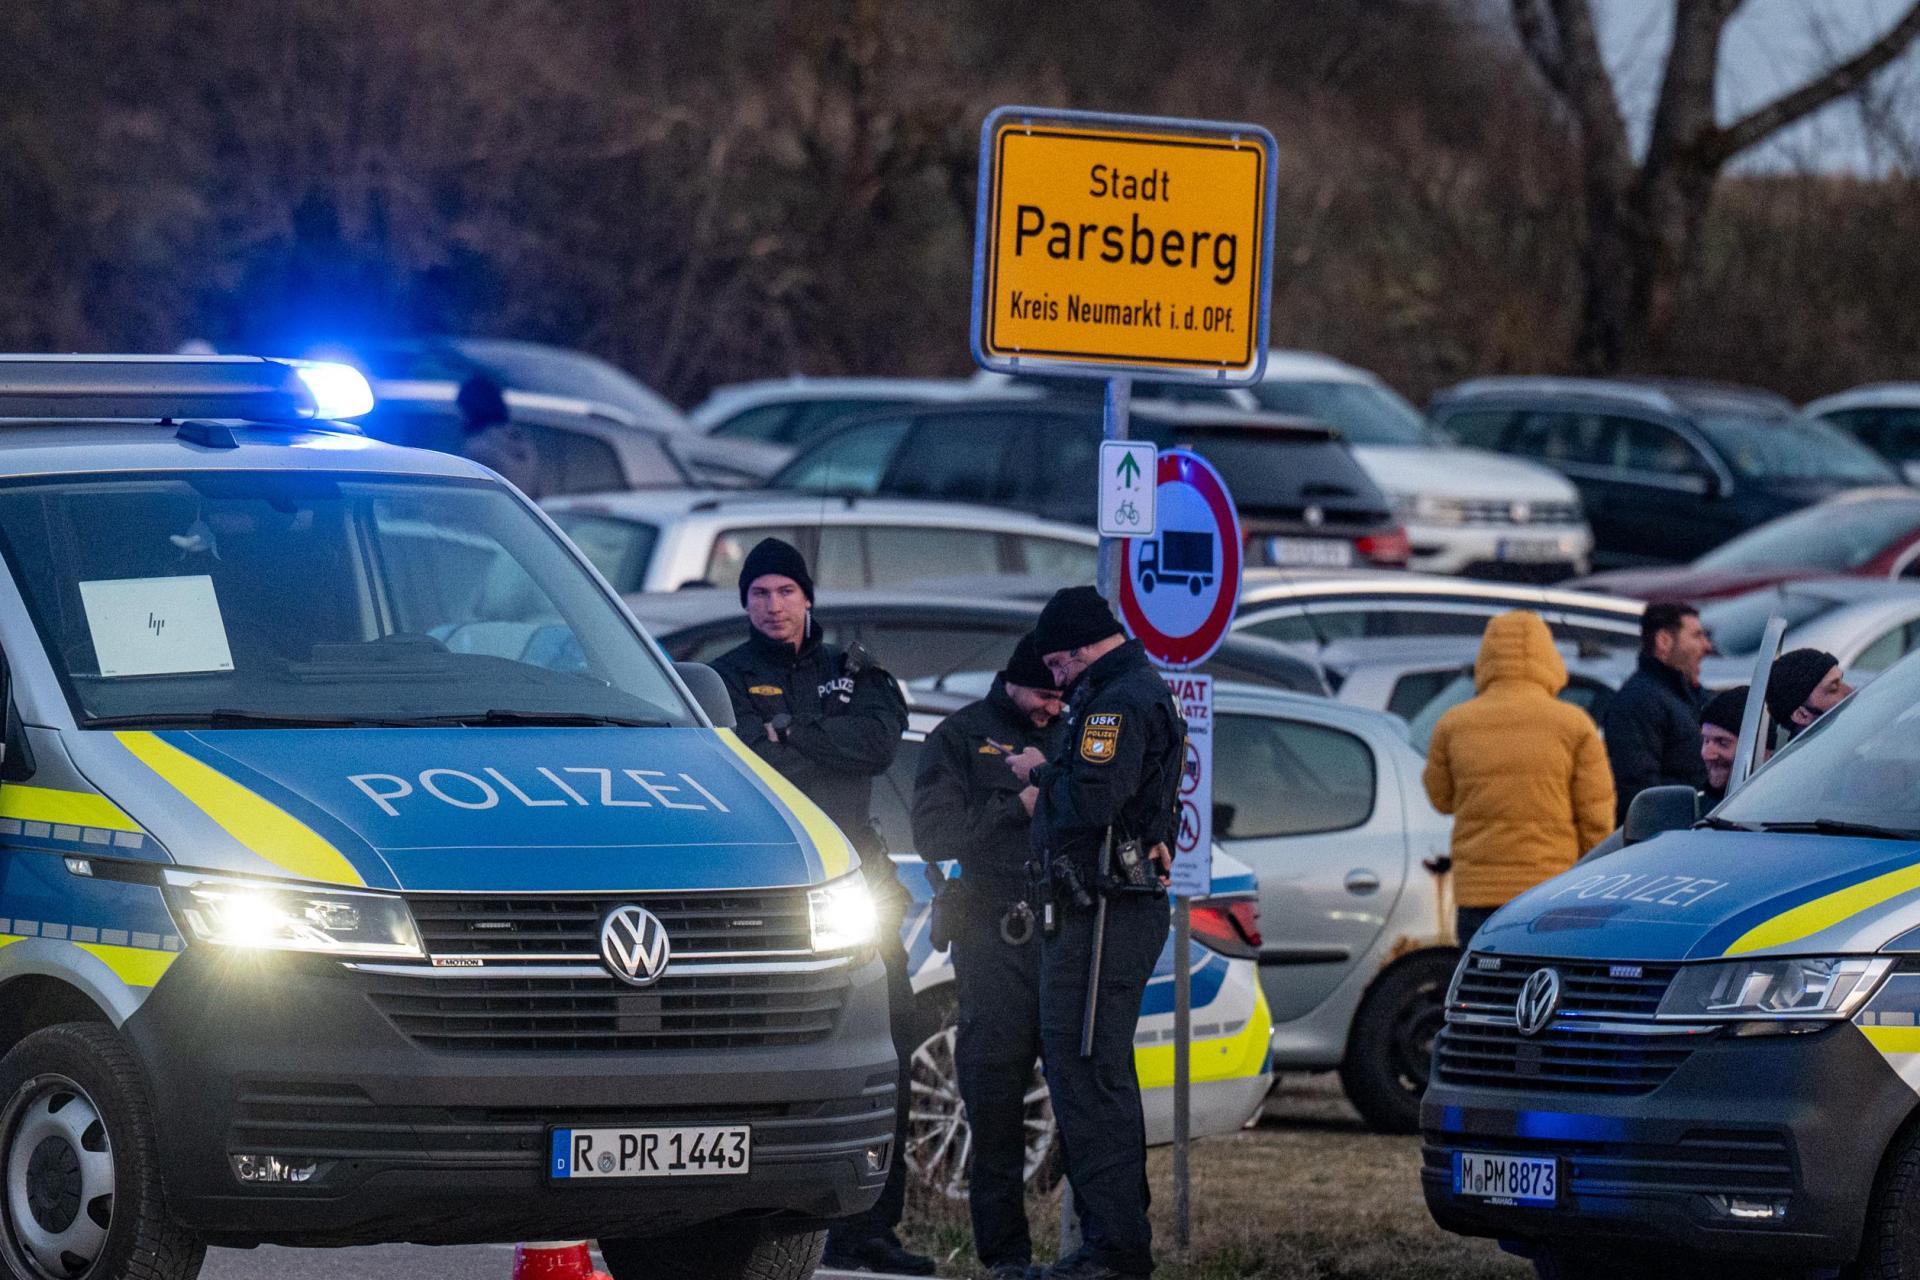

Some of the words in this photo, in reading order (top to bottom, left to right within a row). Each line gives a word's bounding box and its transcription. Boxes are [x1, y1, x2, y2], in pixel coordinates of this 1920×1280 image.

[1089, 164, 1170, 201] Stadt
[1014, 204, 1238, 285] Parsberg
[1010, 290, 1059, 321] Kreis
[1067, 294, 1161, 328] Neumarkt
[817, 677, 854, 698] POLIZE
[1168, 679, 1207, 702] VAT
[1087, 730, 1115, 738] POLIZEI
[1090, 716, 1116, 726] USK
[346, 767, 731, 818] POLIZEI
[1549, 873, 1730, 908] POLIZEI
[557, 1158, 565, 1170] D
[573, 1134, 594, 1172] R
[619, 1133, 659, 1171] PR
[668, 1132, 746, 1170] 1443
[1463, 1158, 1473, 1190] M
[1484, 1159, 1505, 1193] PM
[1509, 1161, 1554, 1196] 8873
